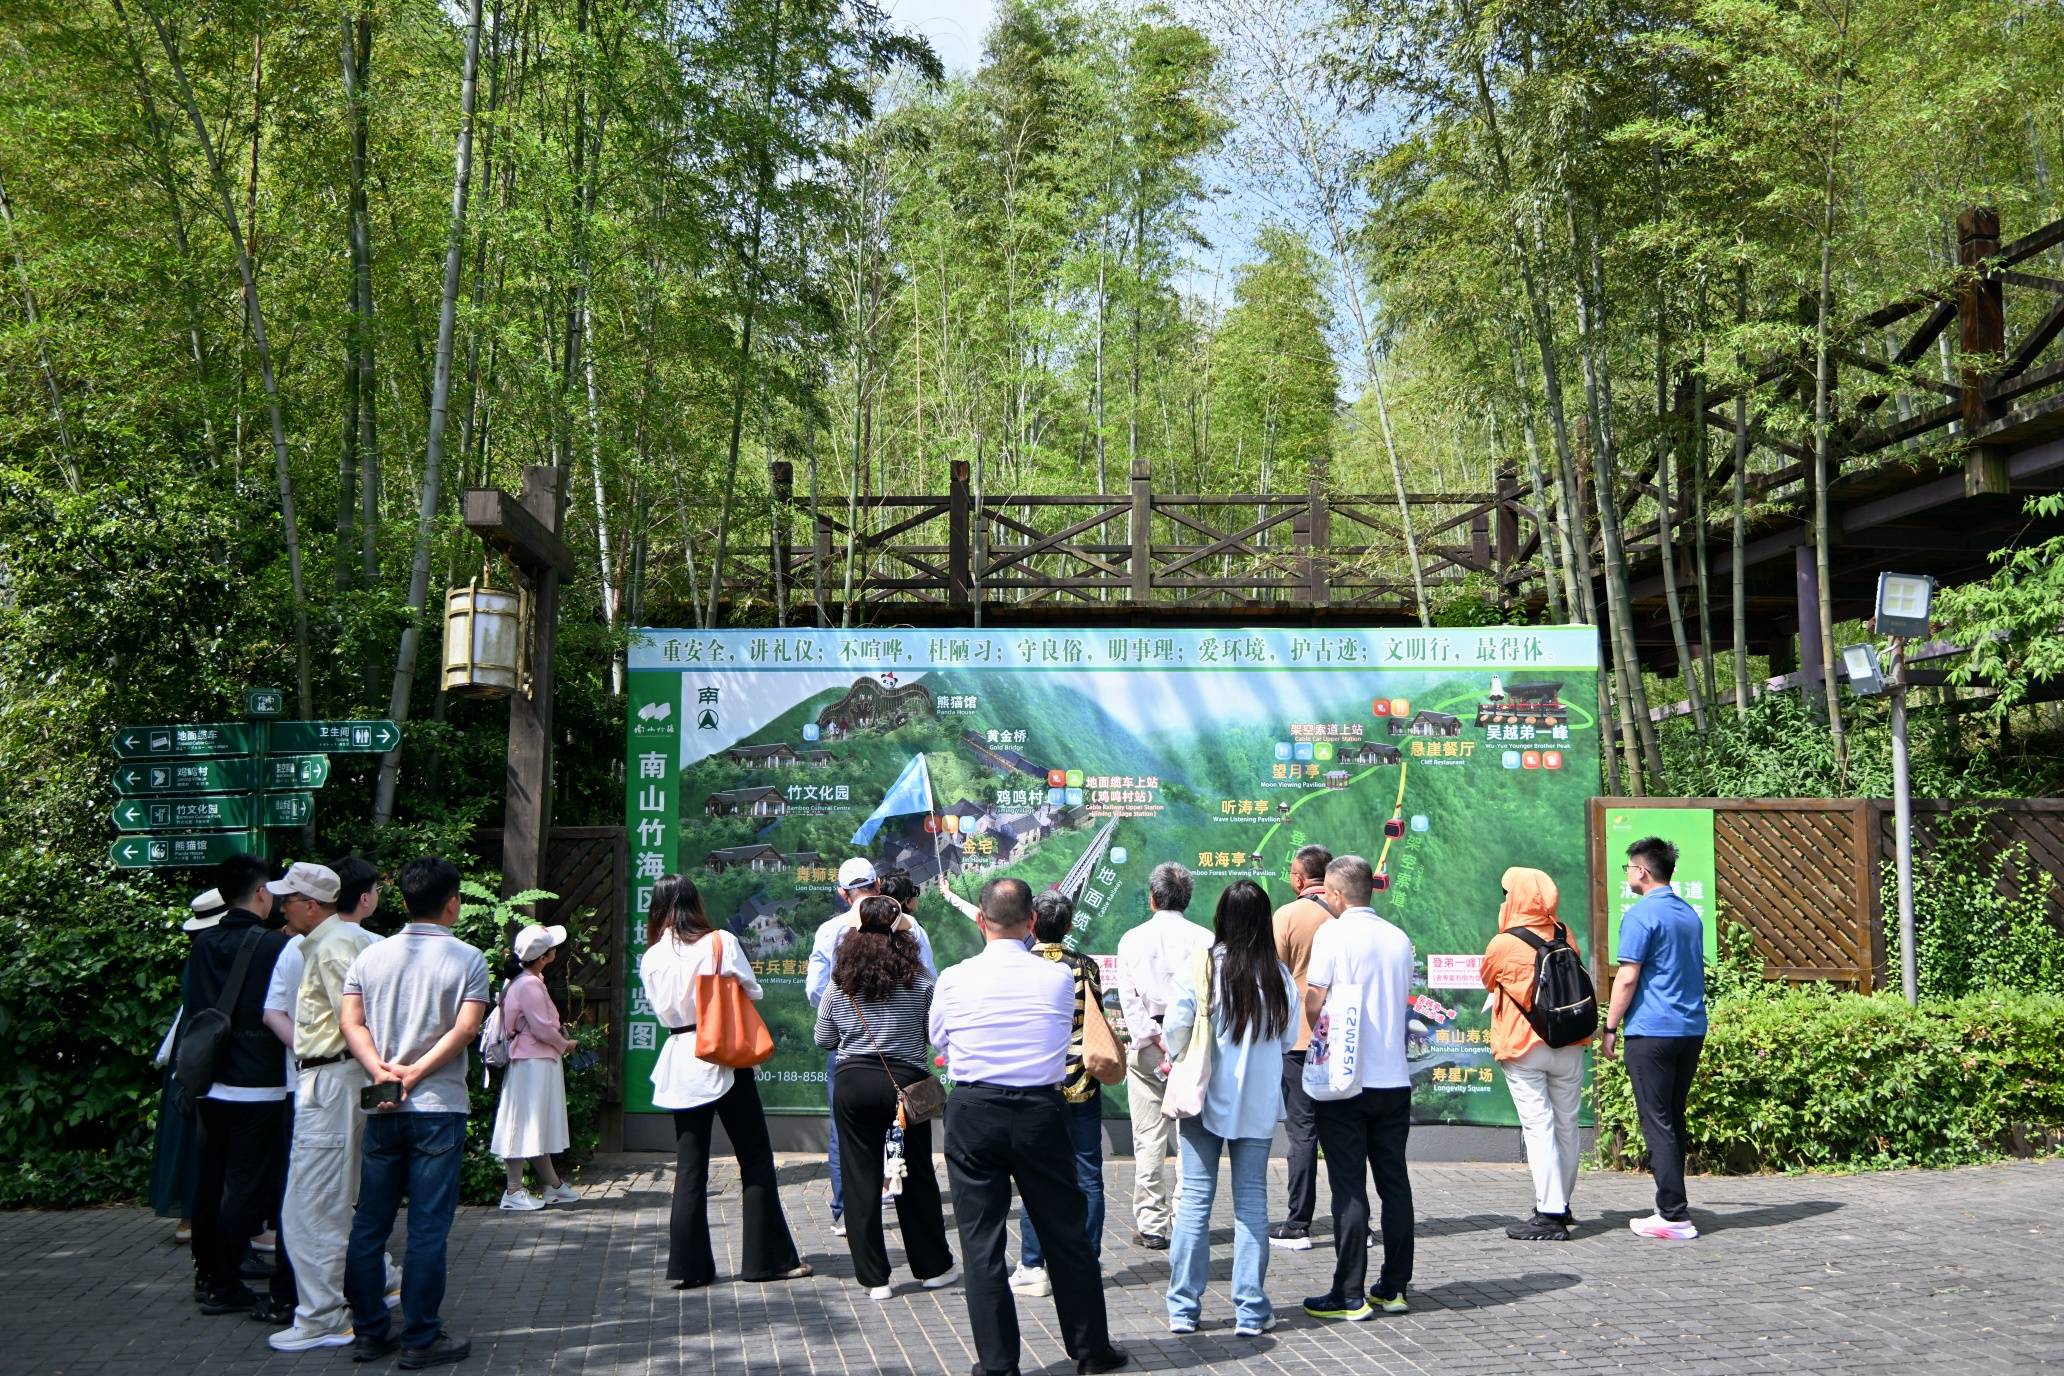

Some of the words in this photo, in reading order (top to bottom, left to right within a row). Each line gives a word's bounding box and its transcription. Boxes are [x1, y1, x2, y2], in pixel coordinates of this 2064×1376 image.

[698, 686, 720, 705] 南
[936, 695, 977, 709] 熊猫馆
[177, 729, 218, 741] 地面缆车
[319, 727, 350, 737] 卫生间
[986, 729, 1027, 743] 黄金桥
[1290, 723, 1364, 736] 架空索道上站
[1486, 724, 1569, 741] 吴越弟一峰
[1004, 744, 1024, 752] Bridge
[1410, 741, 1475, 757] 悬崖餐厅
[1272, 763, 1320, 779] 望月亭
[1086, 776, 1159, 789] 地面缆车上站
[787, 784, 849, 801] 竹文化园
[996, 789, 1044, 805] 鸡鸣村
[176, 803, 218, 815] 竹文化园
[1221, 799, 1269, 815] 听涛亭
[175, 840, 208, 851] 熊猫馆
[962, 839, 993, 854] 金宅
[1198, 851, 1246, 867] 观海亭
[1390, 835, 1421, 907] 架空索道
[1063, 866, 1116, 951] 地面缆车
[1430, 1045, 1459, 1053] Nanshan
[1432, 1067, 1493, 1083] 寿星广场
[1433, 1084, 1467, 1094] Longevity
[1467, 1084, 1492, 1093] Square
